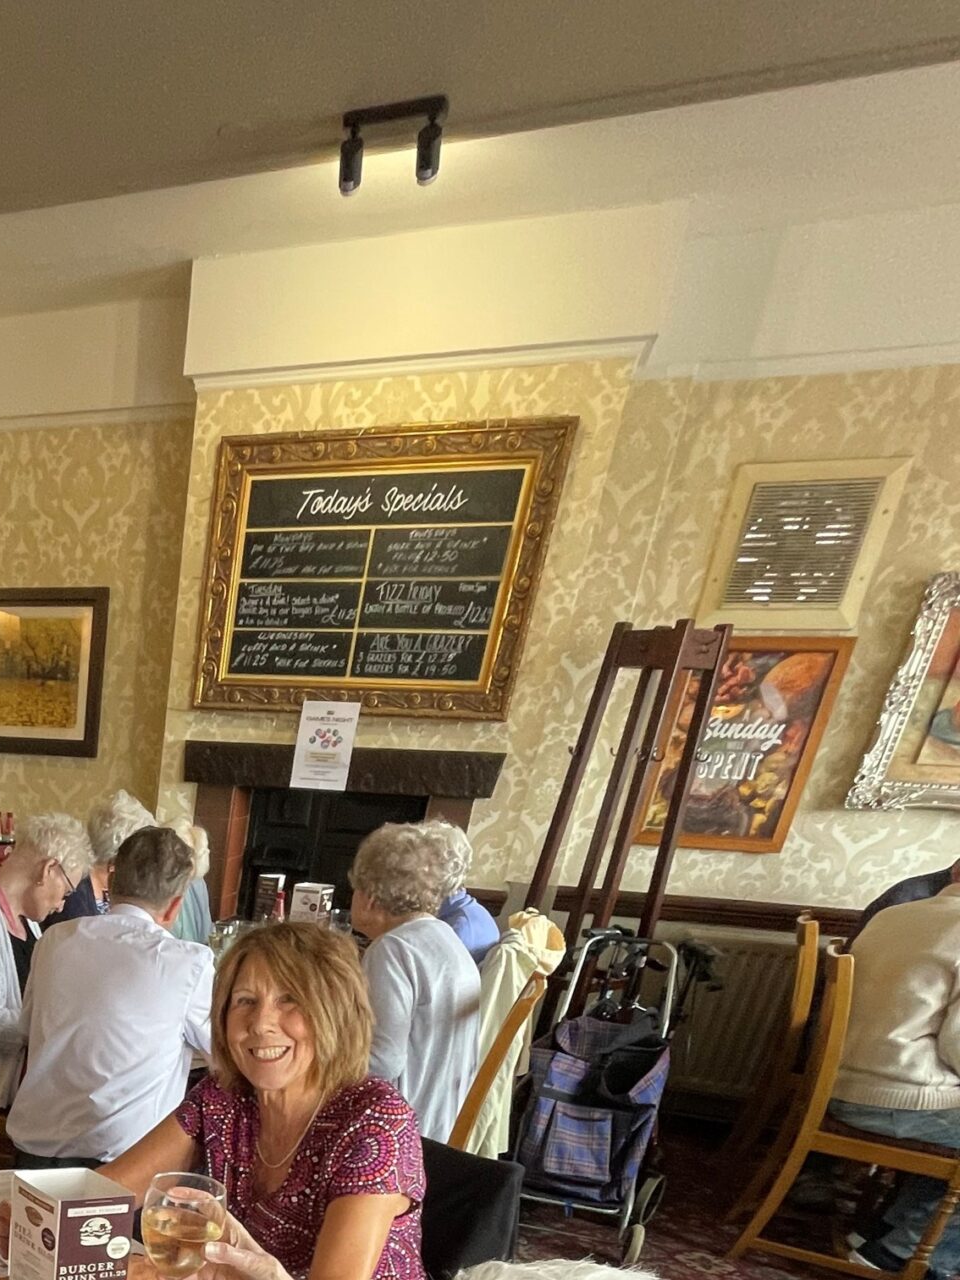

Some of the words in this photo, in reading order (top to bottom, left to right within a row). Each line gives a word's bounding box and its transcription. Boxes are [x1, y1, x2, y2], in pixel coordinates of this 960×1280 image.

[297, 488, 373, 519] Today's
[381, 483, 469, 518] Specials
[376, 580, 406, 601] FIZZ
[408, 580, 442, 602] FRIDAY
[704, 715, 786, 751] Sunday
[696, 750, 764, 780] SPENT
[59, 1262, 114, 1275] BURGER
